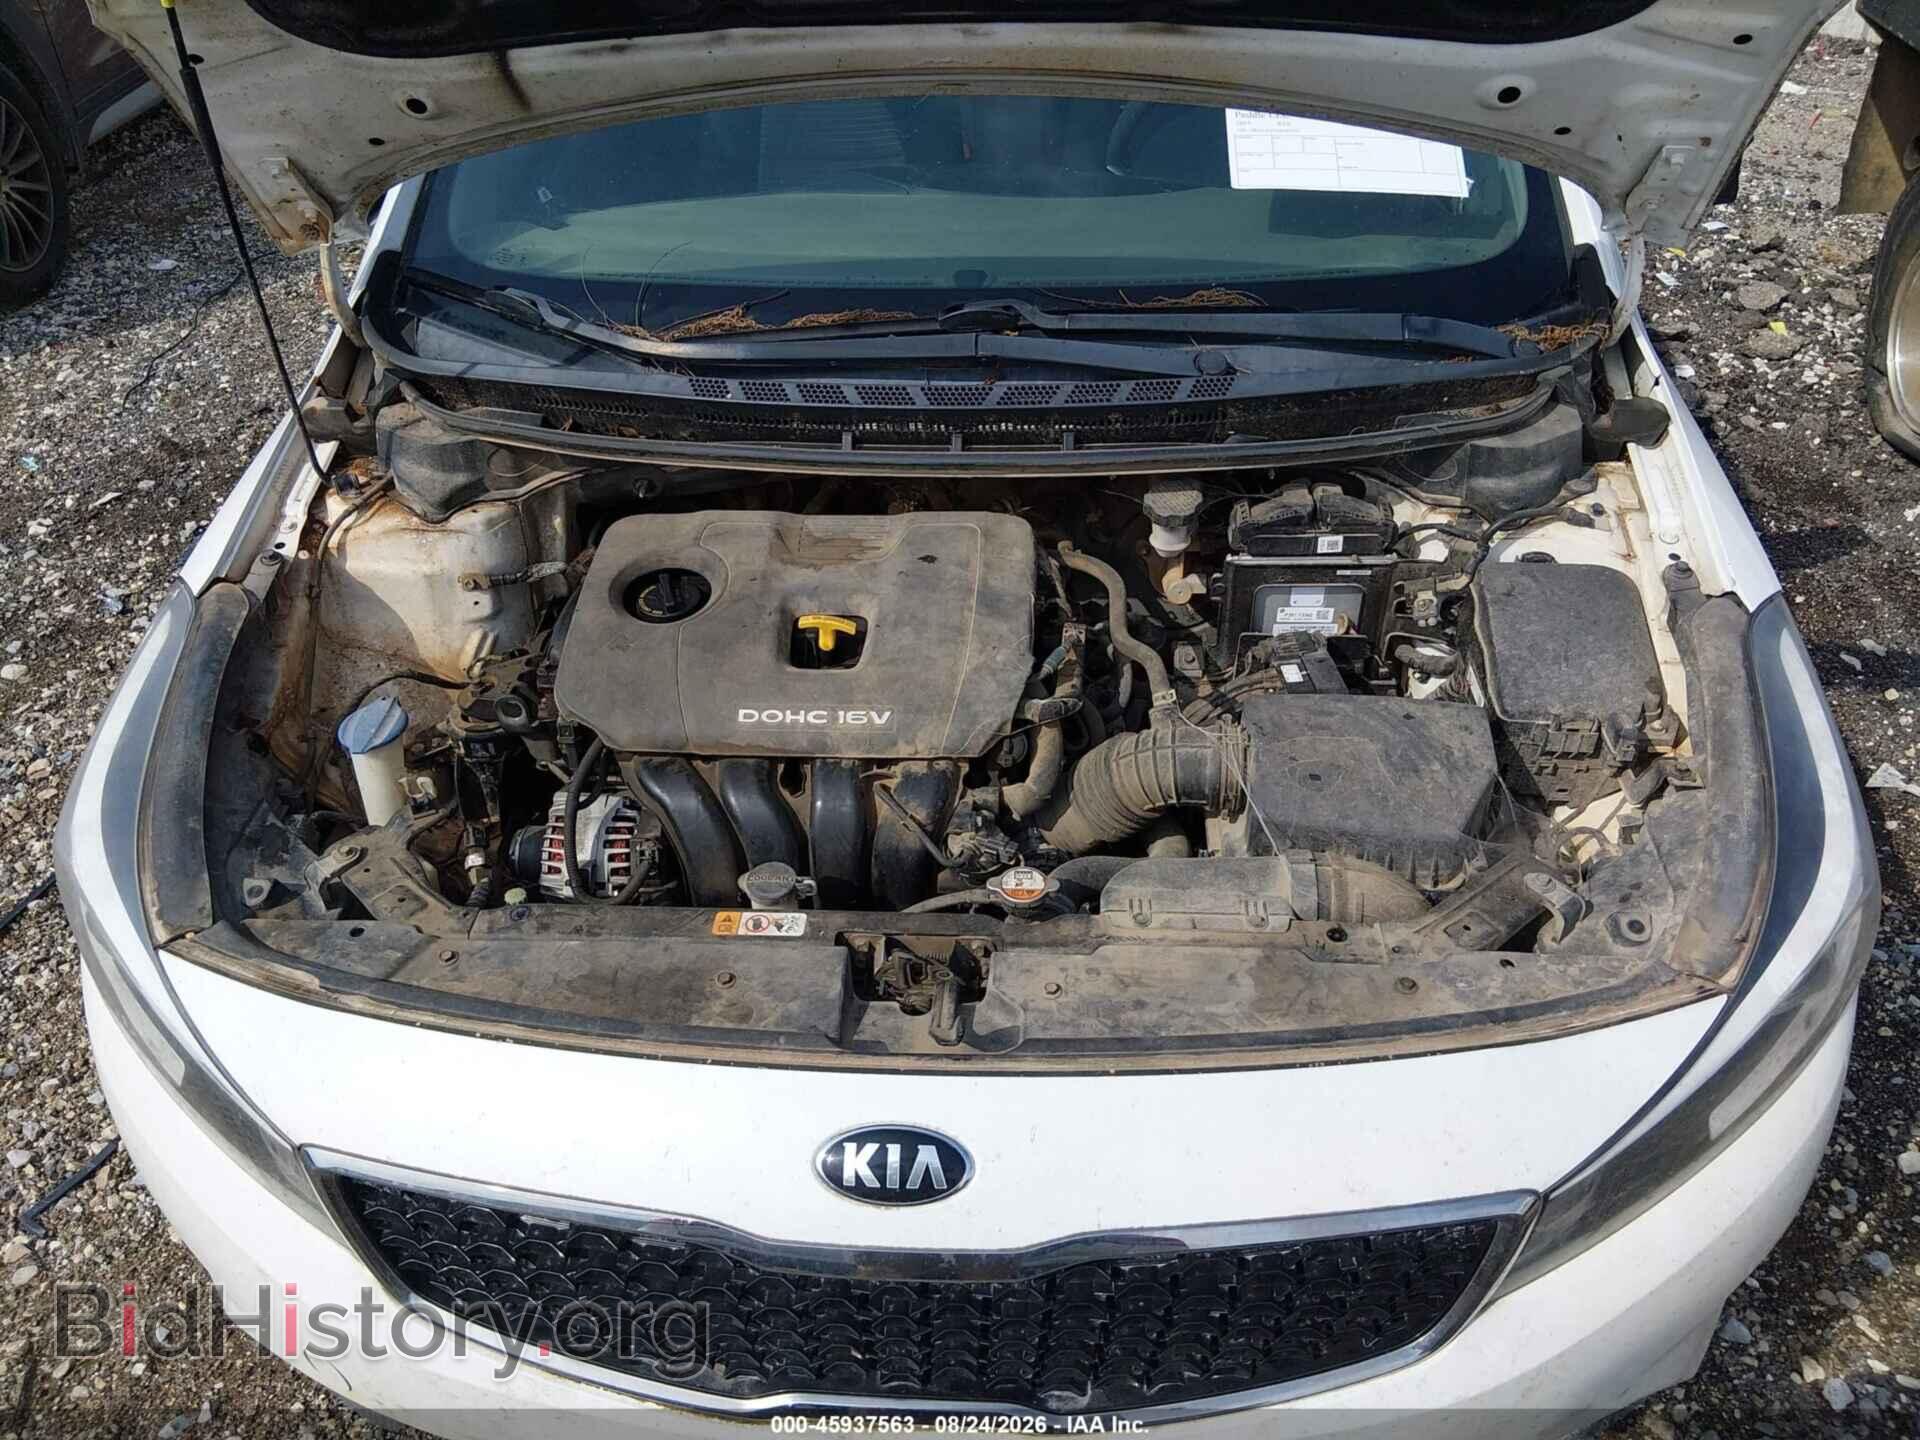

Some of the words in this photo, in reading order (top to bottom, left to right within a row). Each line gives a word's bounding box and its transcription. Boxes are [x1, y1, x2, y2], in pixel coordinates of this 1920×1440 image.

[738, 709, 828, 723] DOHC
[838, 711, 892, 724] 16V
[842, 1142, 948, 1190] KIA
